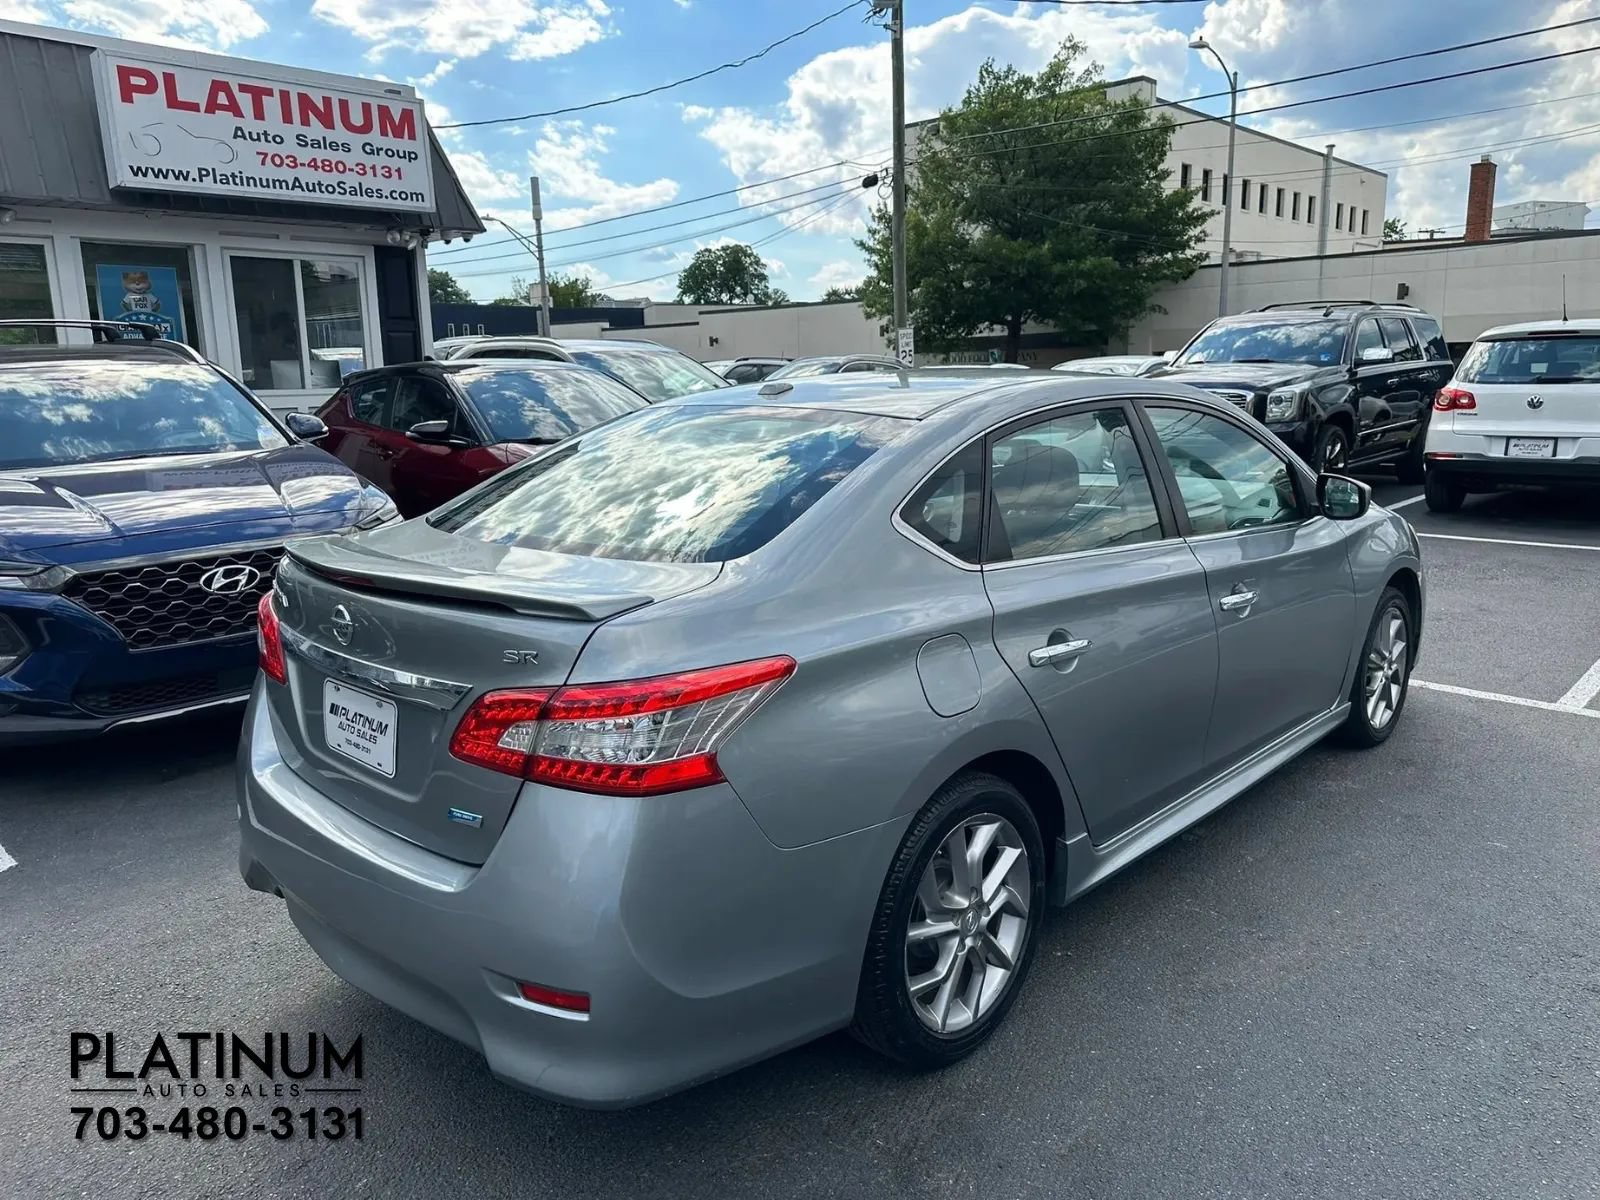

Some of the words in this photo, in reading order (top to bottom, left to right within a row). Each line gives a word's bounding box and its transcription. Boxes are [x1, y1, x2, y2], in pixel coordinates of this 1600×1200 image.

[116, 64, 416, 141] PLATINUM
[232, 126, 285, 145] Auto
[296, 133, 352, 153] Sales
[361, 142, 418, 162] Group
[255, 151, 403, 180] 703-480-3131
[128, 163, 425, 202] www.PlatinumAutoSales.com
[901, 350, 913, 364] 25
[503, 649, 539, 665] SR
[338, 721, 355, 735] AUTO
[356, 729, 378, 744] SALES
[339, 706, 389, 737] PLATINUM
